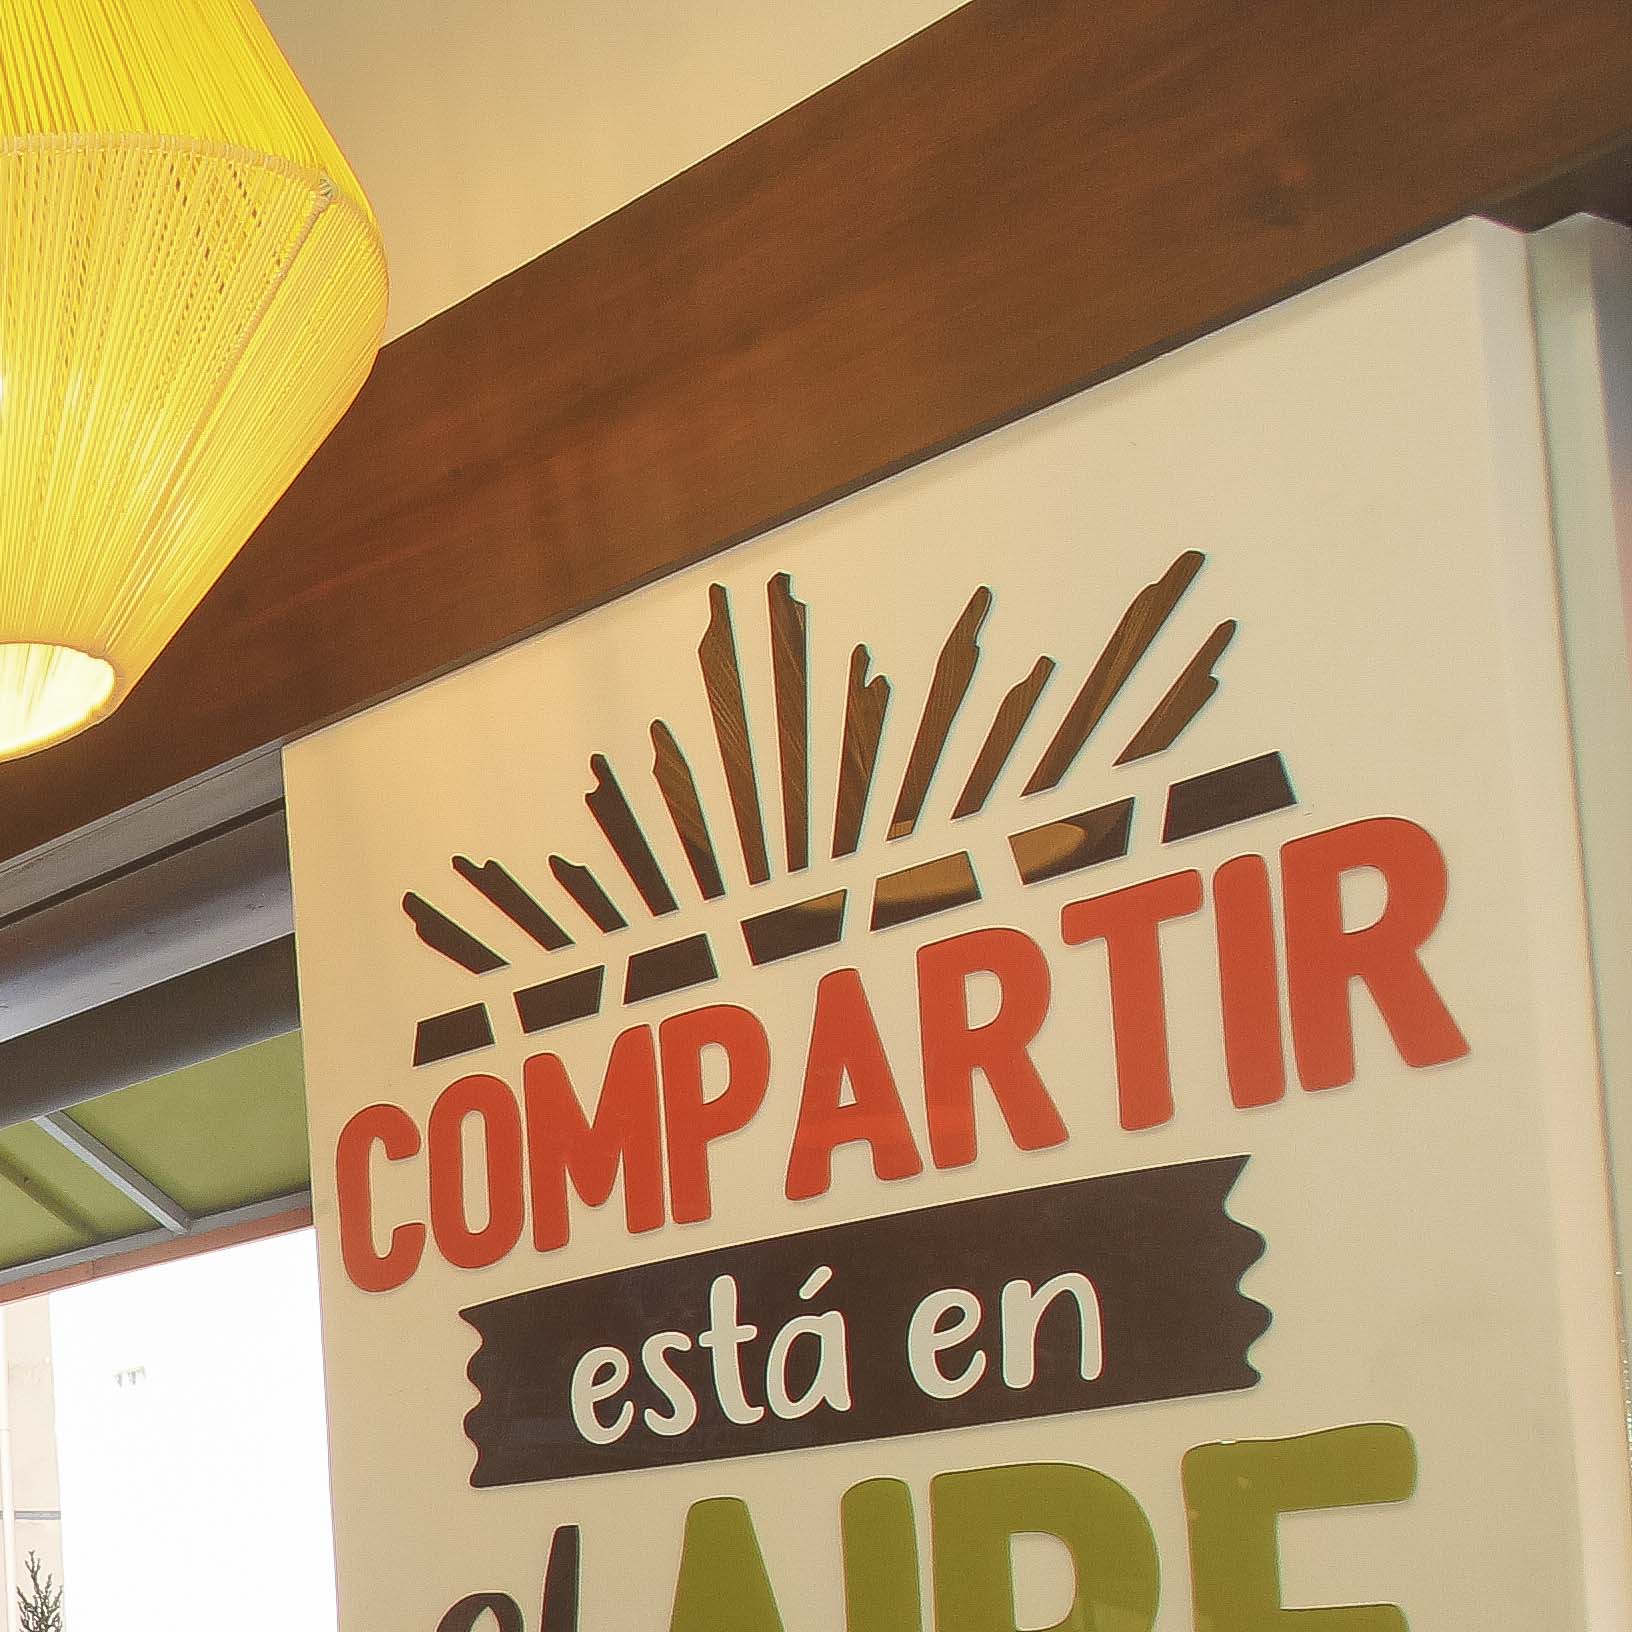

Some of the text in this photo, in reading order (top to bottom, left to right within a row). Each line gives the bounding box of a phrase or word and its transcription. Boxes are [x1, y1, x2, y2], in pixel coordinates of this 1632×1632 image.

[335, 817, 1470, 1292] COMPARTIR
[571, 1265, 1104, 1444] está en
